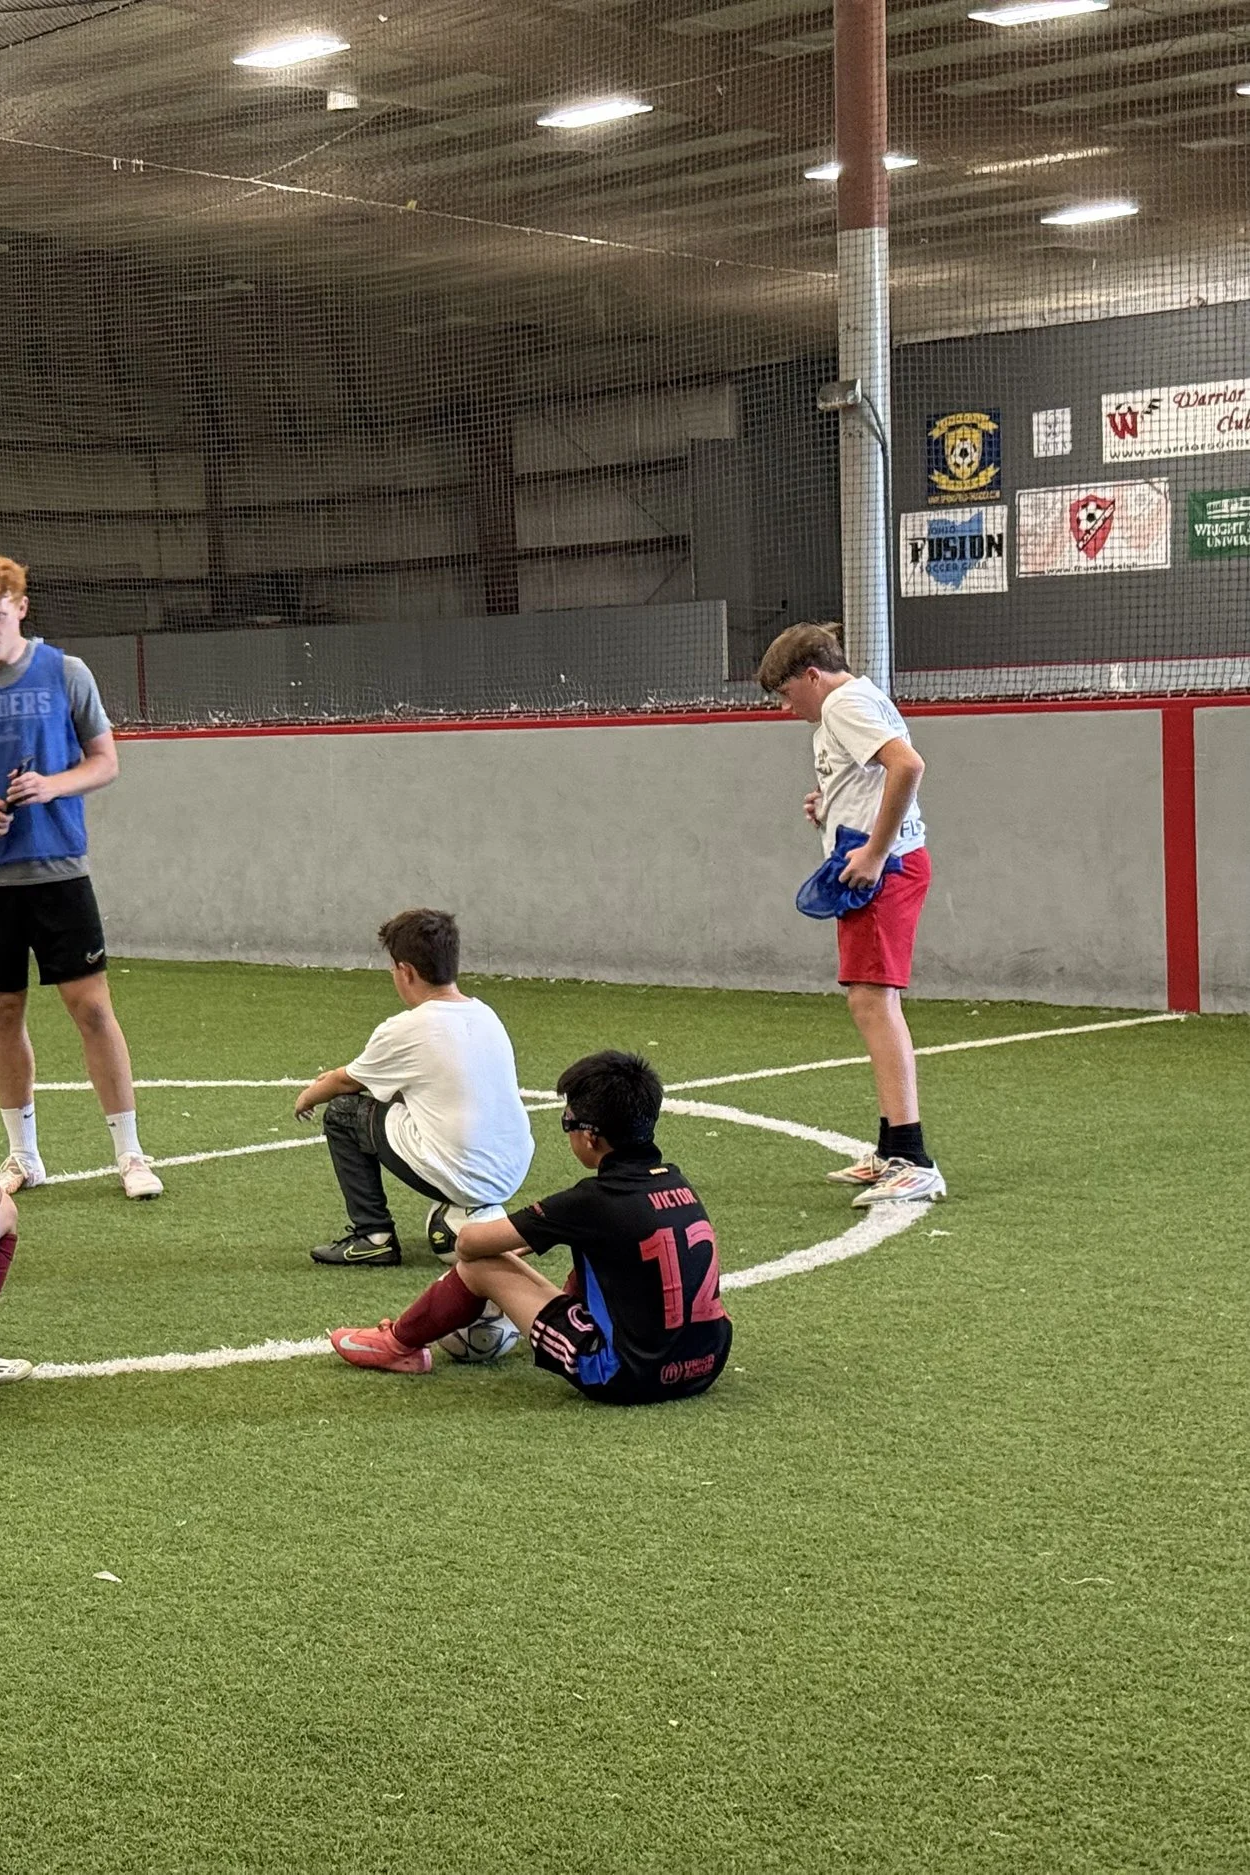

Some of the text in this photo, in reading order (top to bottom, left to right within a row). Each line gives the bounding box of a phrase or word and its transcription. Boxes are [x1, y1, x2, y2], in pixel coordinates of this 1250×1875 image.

[1173, 384, 1246, 408] Warrior
[930, 525, 956, 535] OHIO
[1206, 534, 1250, 548] UNIVER
[907, 532, 1003, 563] FUSION
[648, 1187, 698, 1210] VICTOR
[639, 1220, 728, 1329] 12
